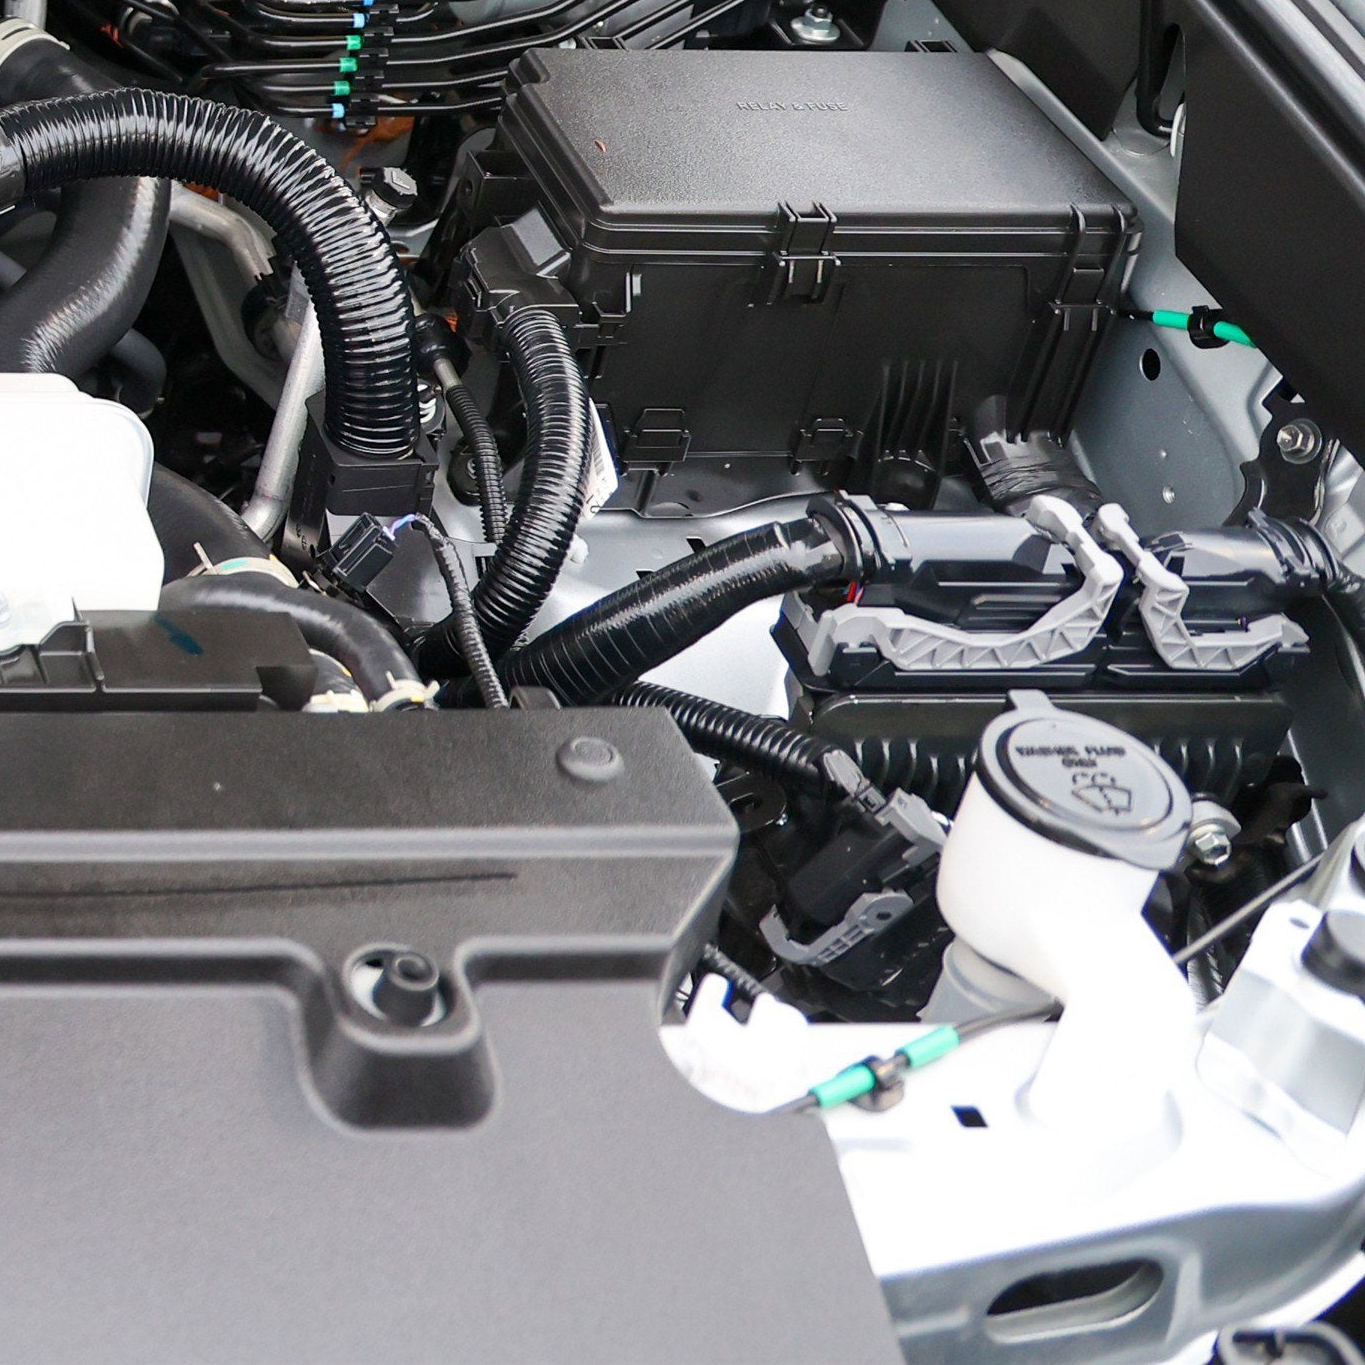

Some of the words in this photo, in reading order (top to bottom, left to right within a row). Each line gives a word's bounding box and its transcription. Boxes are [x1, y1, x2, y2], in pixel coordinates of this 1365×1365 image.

[735, 100, 787, 111] RELAY
[791, 101, 805, 111] &
[806, 101, 849, 112] FUSE
